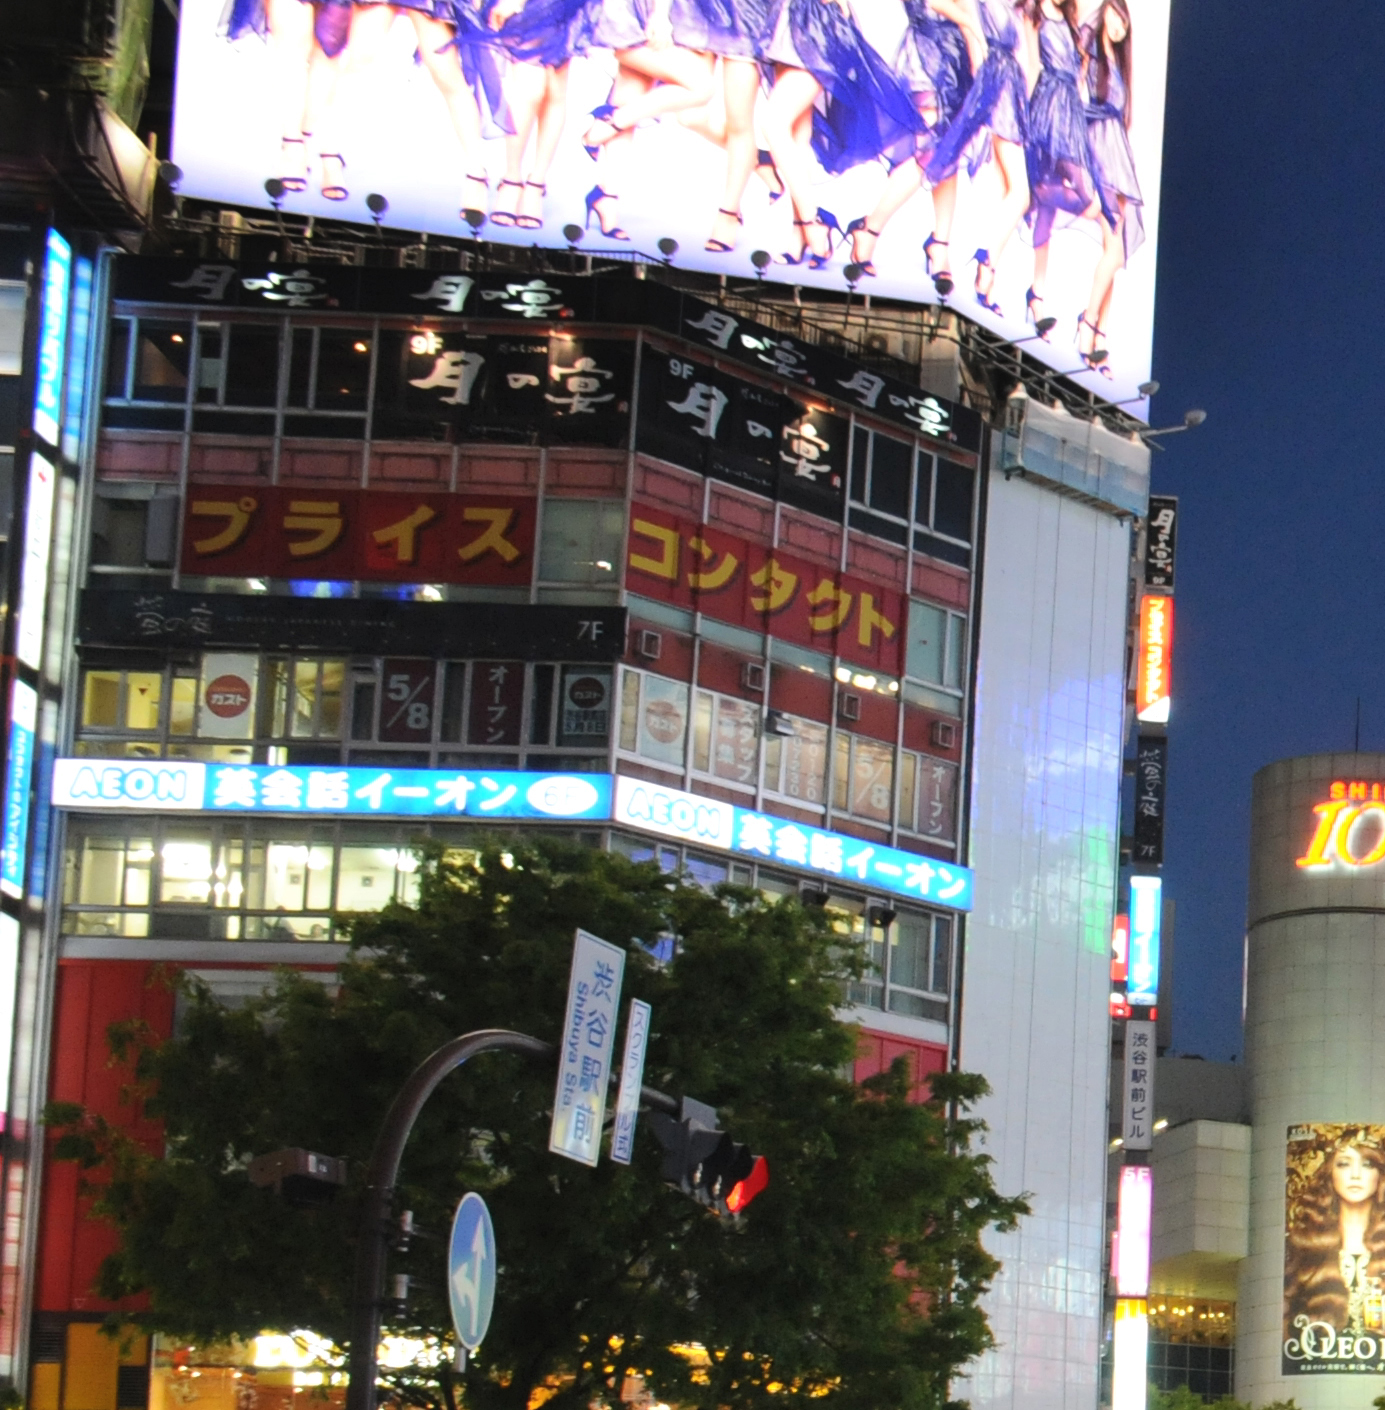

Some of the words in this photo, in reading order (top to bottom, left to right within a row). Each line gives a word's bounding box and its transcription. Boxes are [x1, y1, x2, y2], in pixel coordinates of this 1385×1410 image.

[410, 336, 443, 355] 9F
[669, 359, 695, 380] 9F
[408, 351, 615, 414] 月の宴
[667, 383, 832, 481] 月の宴
[192, 498, 519, 562] プライス
[630, 519, 894, 647] コンタクト
[577, 621, 604, 640] 7F
[211, 693, 247, 705] ガスト
[487, 665, 509, 744] オープン
[71, 766, 187, 801] AEON
[214, 767, 517, 811] 英会話イーオン
[627, 786, 721, 838] AEON
[929, 765, 947, 836] オープン
[739, 812, 965, 899] 英会話イーオン
[1141, 846, 1156, 857] 7F
[567, 981, 589, 1064] Shibuya
[574, 959, 615, 1145] 渋谷駅前
[562, 1072, 578, 1112] Sta.
[1129, 1032, 1150, 1139] 渋谷駅前ビル
[1124, 1167, 1151, 1182] 5F
